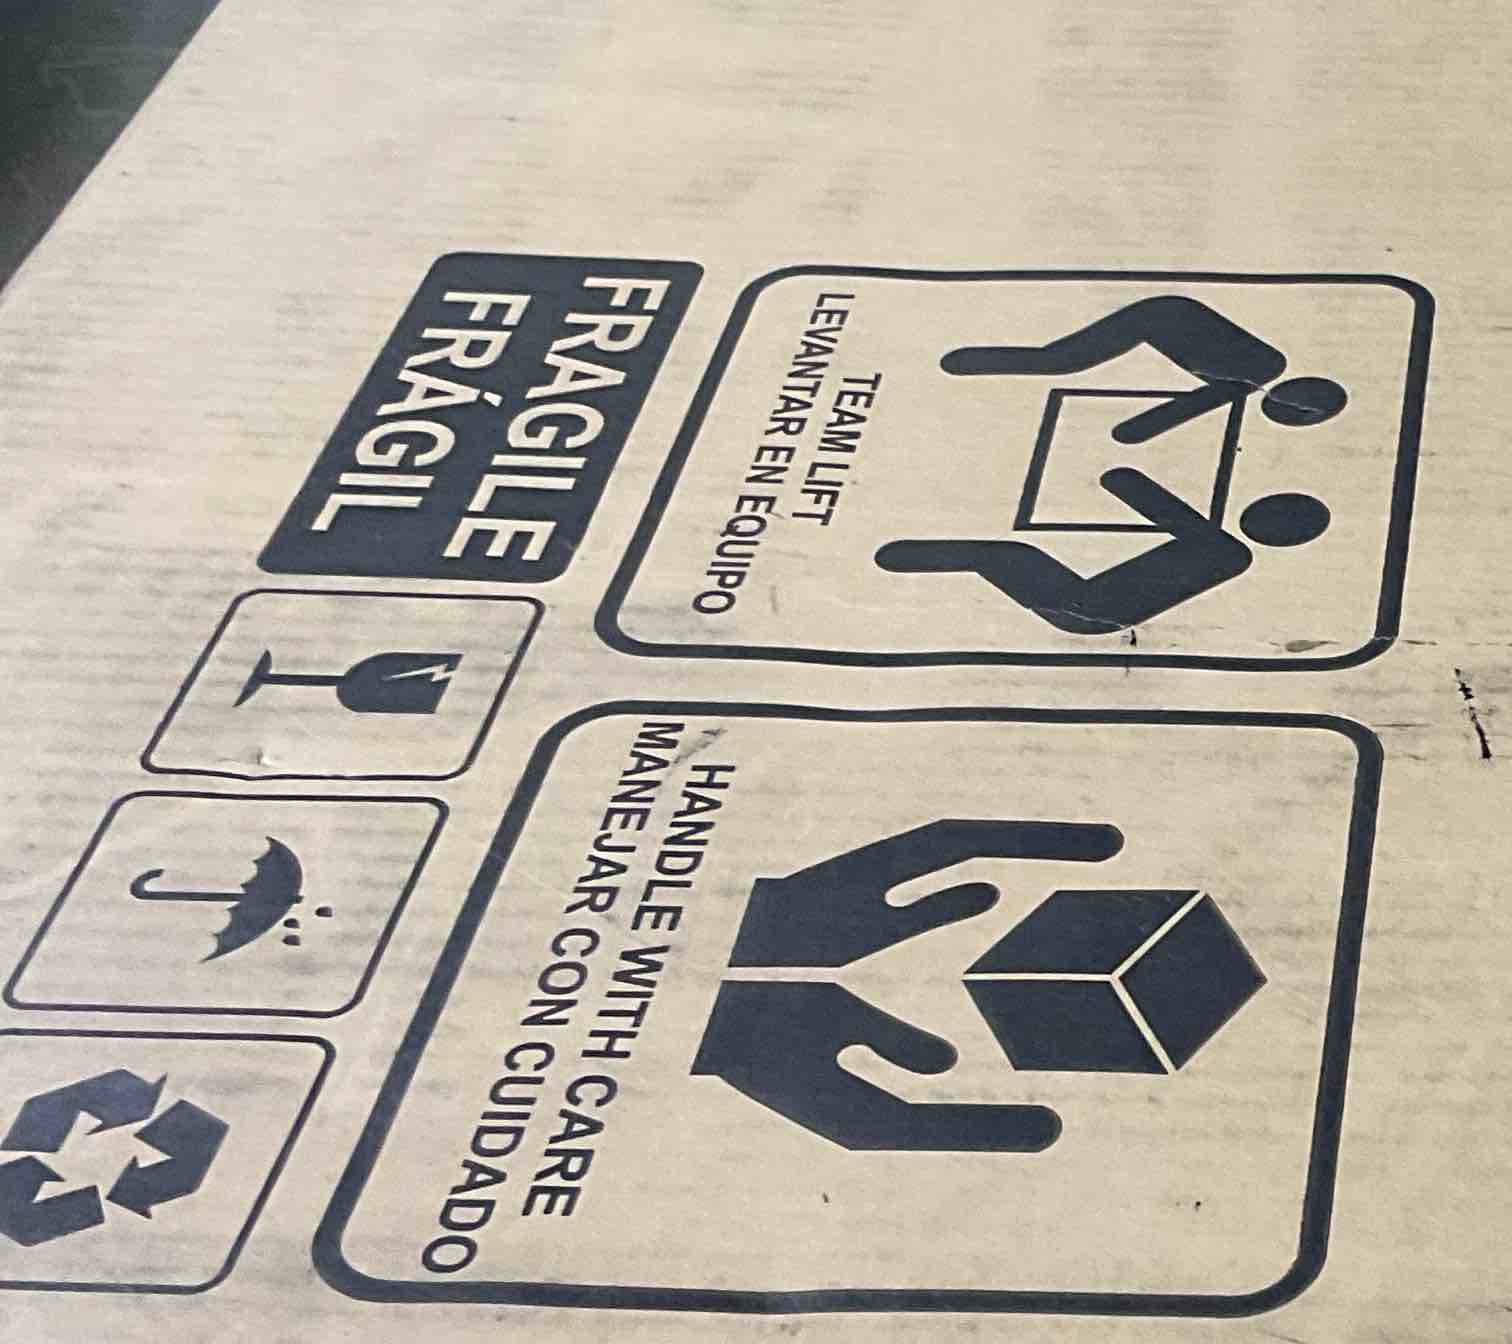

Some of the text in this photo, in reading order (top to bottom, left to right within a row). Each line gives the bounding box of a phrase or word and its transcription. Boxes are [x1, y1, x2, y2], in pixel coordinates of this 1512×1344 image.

[310, 291, 532, 531] FRÁGIL
[442, 276, 671, 561] FRAGILE
[692, 292, 856, 615] LEVANTAR EN EQUIPO
[791, 371, 882, 527] TEAM LIFT
[421, 721, 686, 1274] MANEJAR CON CUIDADO
[520, 763, 737, 1218] HANDLE WITH CARE
